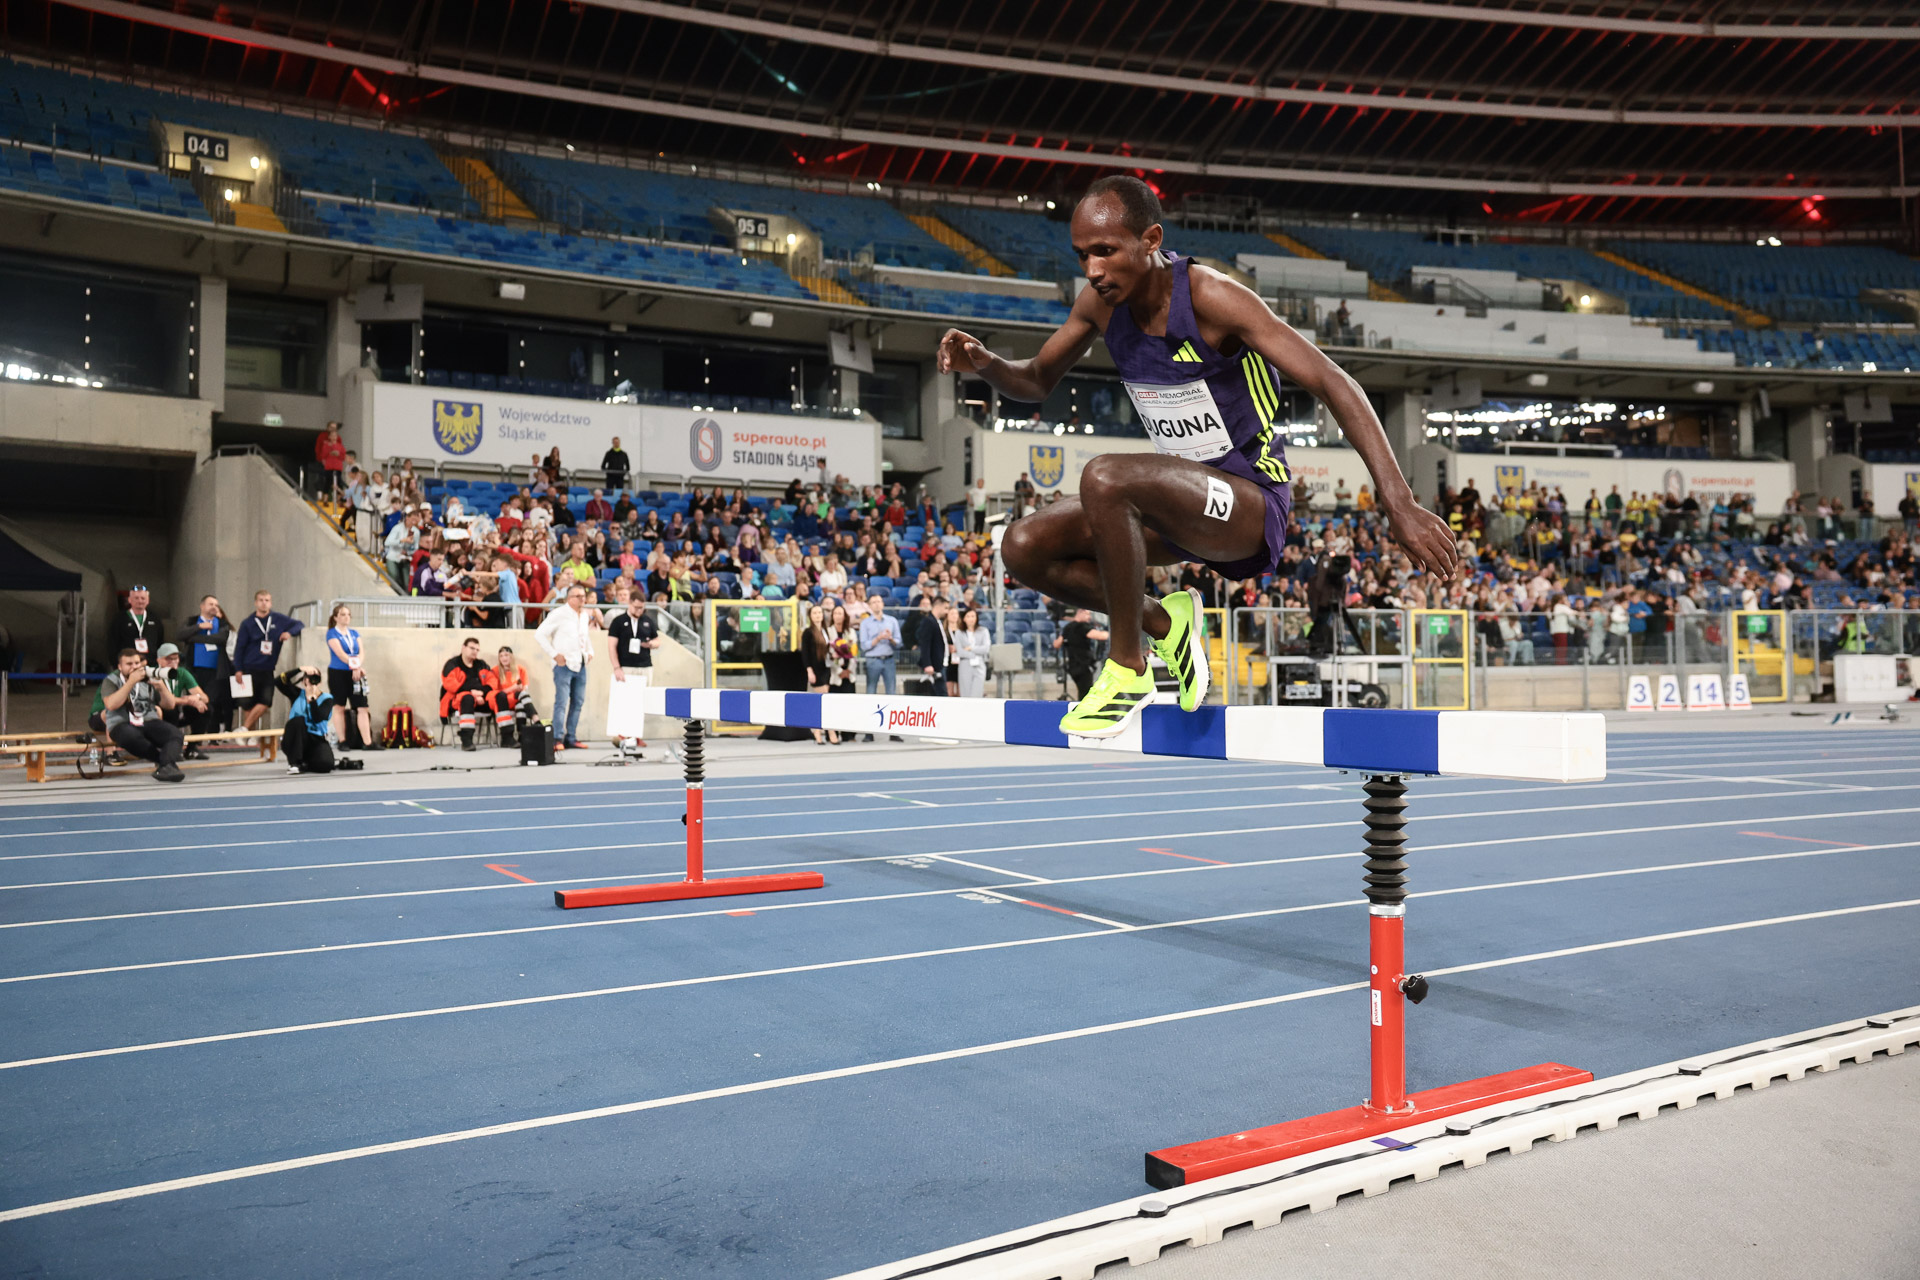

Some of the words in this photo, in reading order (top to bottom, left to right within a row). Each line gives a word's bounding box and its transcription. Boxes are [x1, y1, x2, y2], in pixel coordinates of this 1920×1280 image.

[188, 136, 209, 155] 04
[215, 143, 225, 158] G
[738, 218, 755, 234] 05
[757, 223, 766, 236] G
[499, 407, 592, 426] Województwo
[499, 425, 547, 441] Śląskie
[733, 432, 827, 450] superauto.pl
[733, 450, 783, 466] STADION
[787, 451, 826, 472] ŚLĄS
[1291, 466, 1329, 477] auto.pl
[1634, 683, 1647, 703] 3
[1664, 682, 1675, 702] 2
[1735, 681, 1746, 701] 5
[888, 705, 937, 730] polanik
